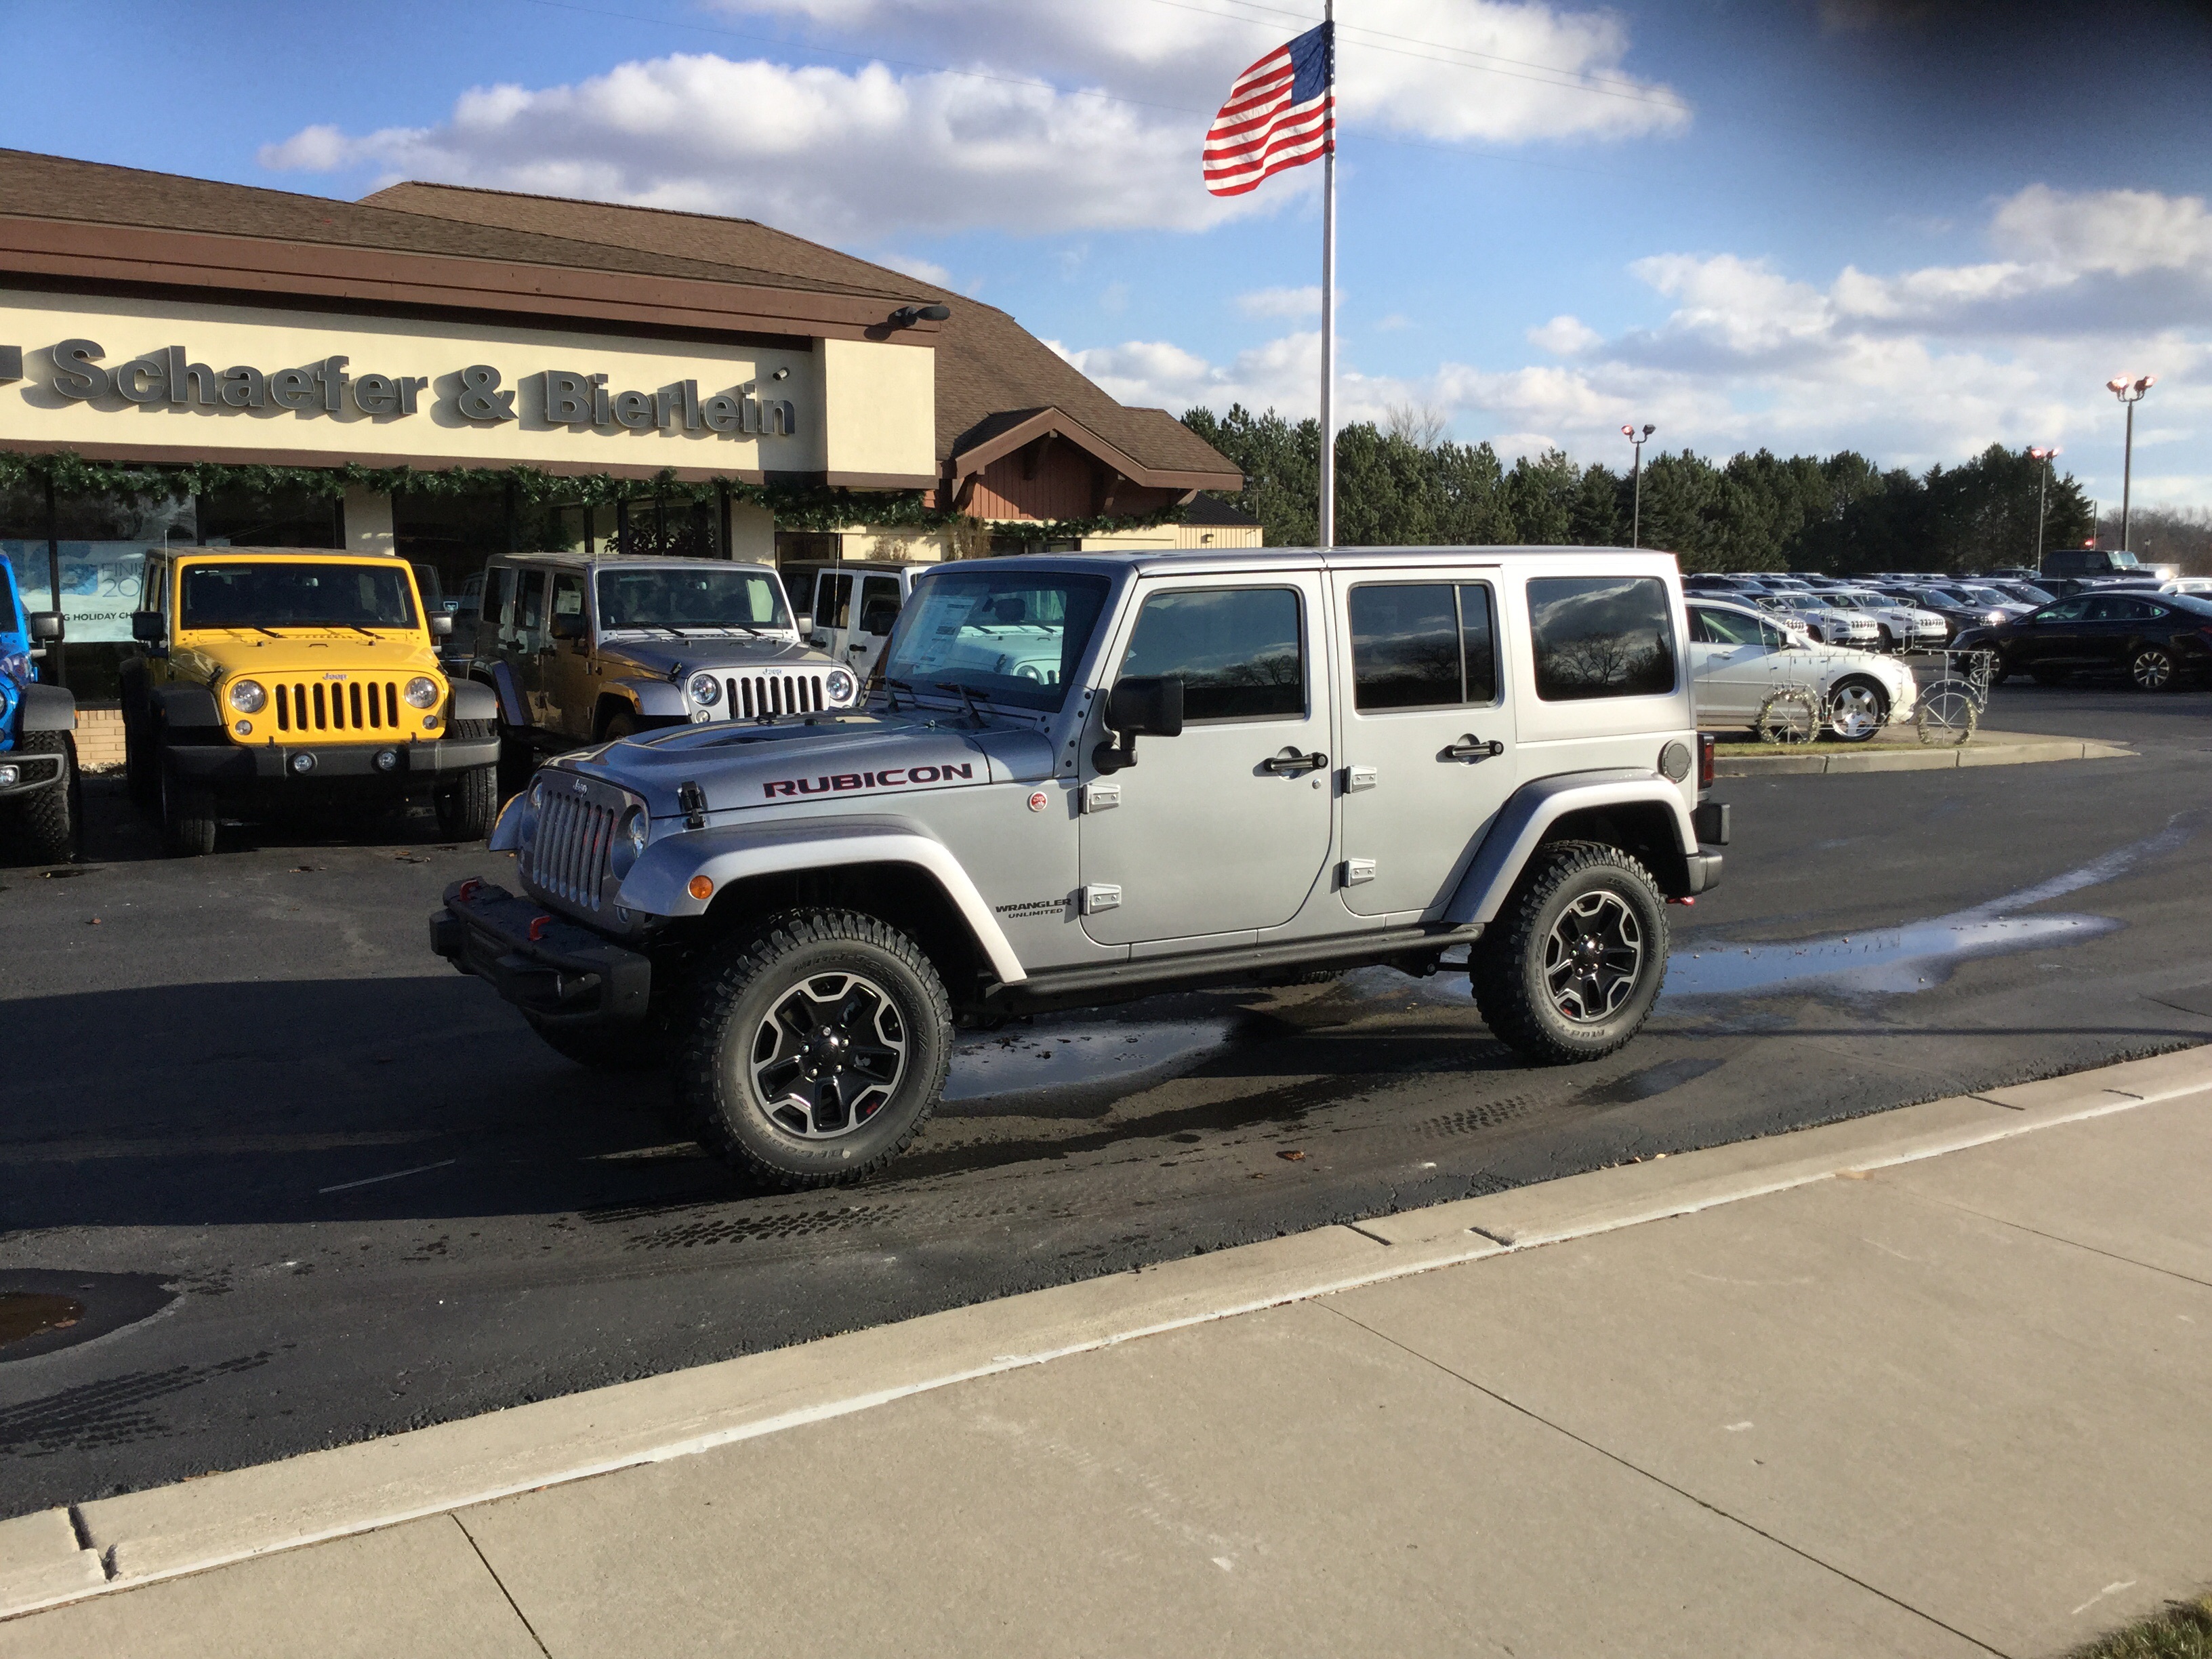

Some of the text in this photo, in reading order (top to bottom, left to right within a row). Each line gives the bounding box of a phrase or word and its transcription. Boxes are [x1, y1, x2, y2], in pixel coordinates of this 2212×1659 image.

[53, 339, 796, 435] Schaefer & Bierlein
[73, 613, 117, 621] HOLIDAY
[762, 762, 973, 798] RUBICON
[996, 898, 1071, 913] WRANGLER
[1008, 908, 1063, 919] UNLIMITED
